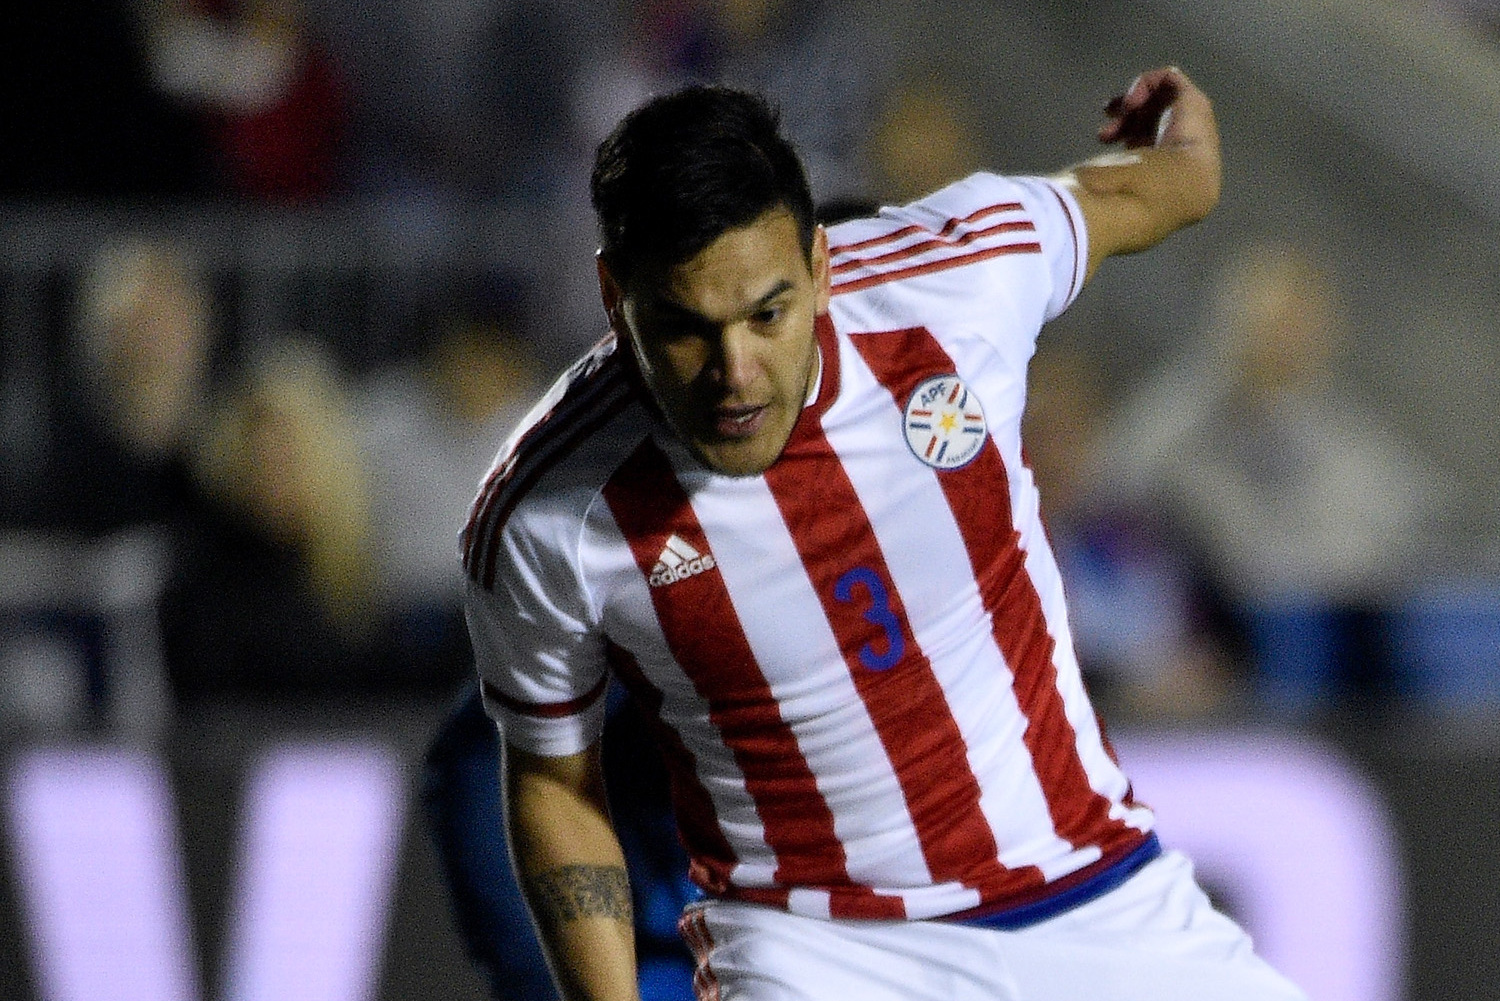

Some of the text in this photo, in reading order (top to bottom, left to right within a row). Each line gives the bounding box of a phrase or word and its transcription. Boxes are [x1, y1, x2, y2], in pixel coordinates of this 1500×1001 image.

[921, 382, 947, 407] APF
[649, 554, 717, 588] adidas
[833, 567, 906, 672] 3
